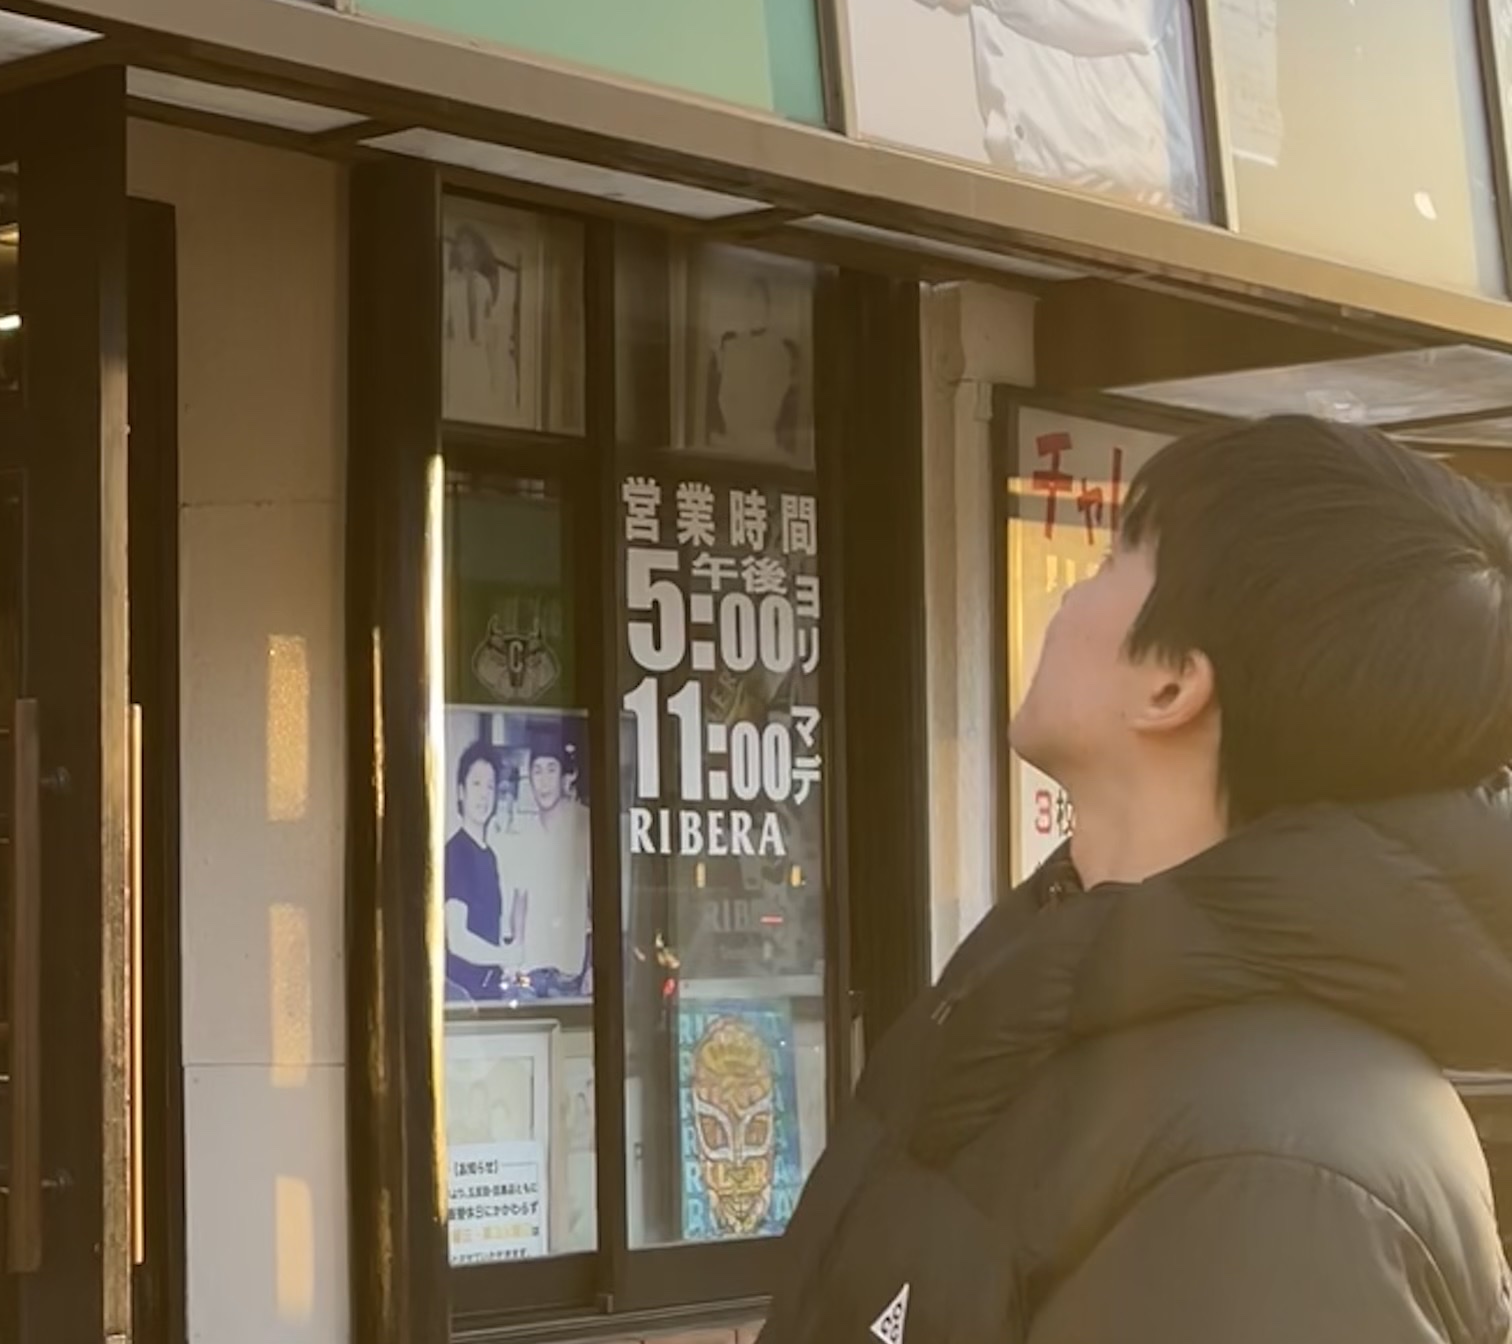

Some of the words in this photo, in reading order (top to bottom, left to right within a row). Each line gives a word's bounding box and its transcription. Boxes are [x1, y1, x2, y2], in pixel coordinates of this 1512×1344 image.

[622, 476, 818, 555] 営業時間
[627, 547, 794, 672] 5:00
[794, 575, 821, 674] ヨリ
[691, 552, 787, 595] 午後
[623, 675, 793, 803] 11:00
[791, 705, 822, 806] マデ
[629, 807, 787, 856] RIBERA
